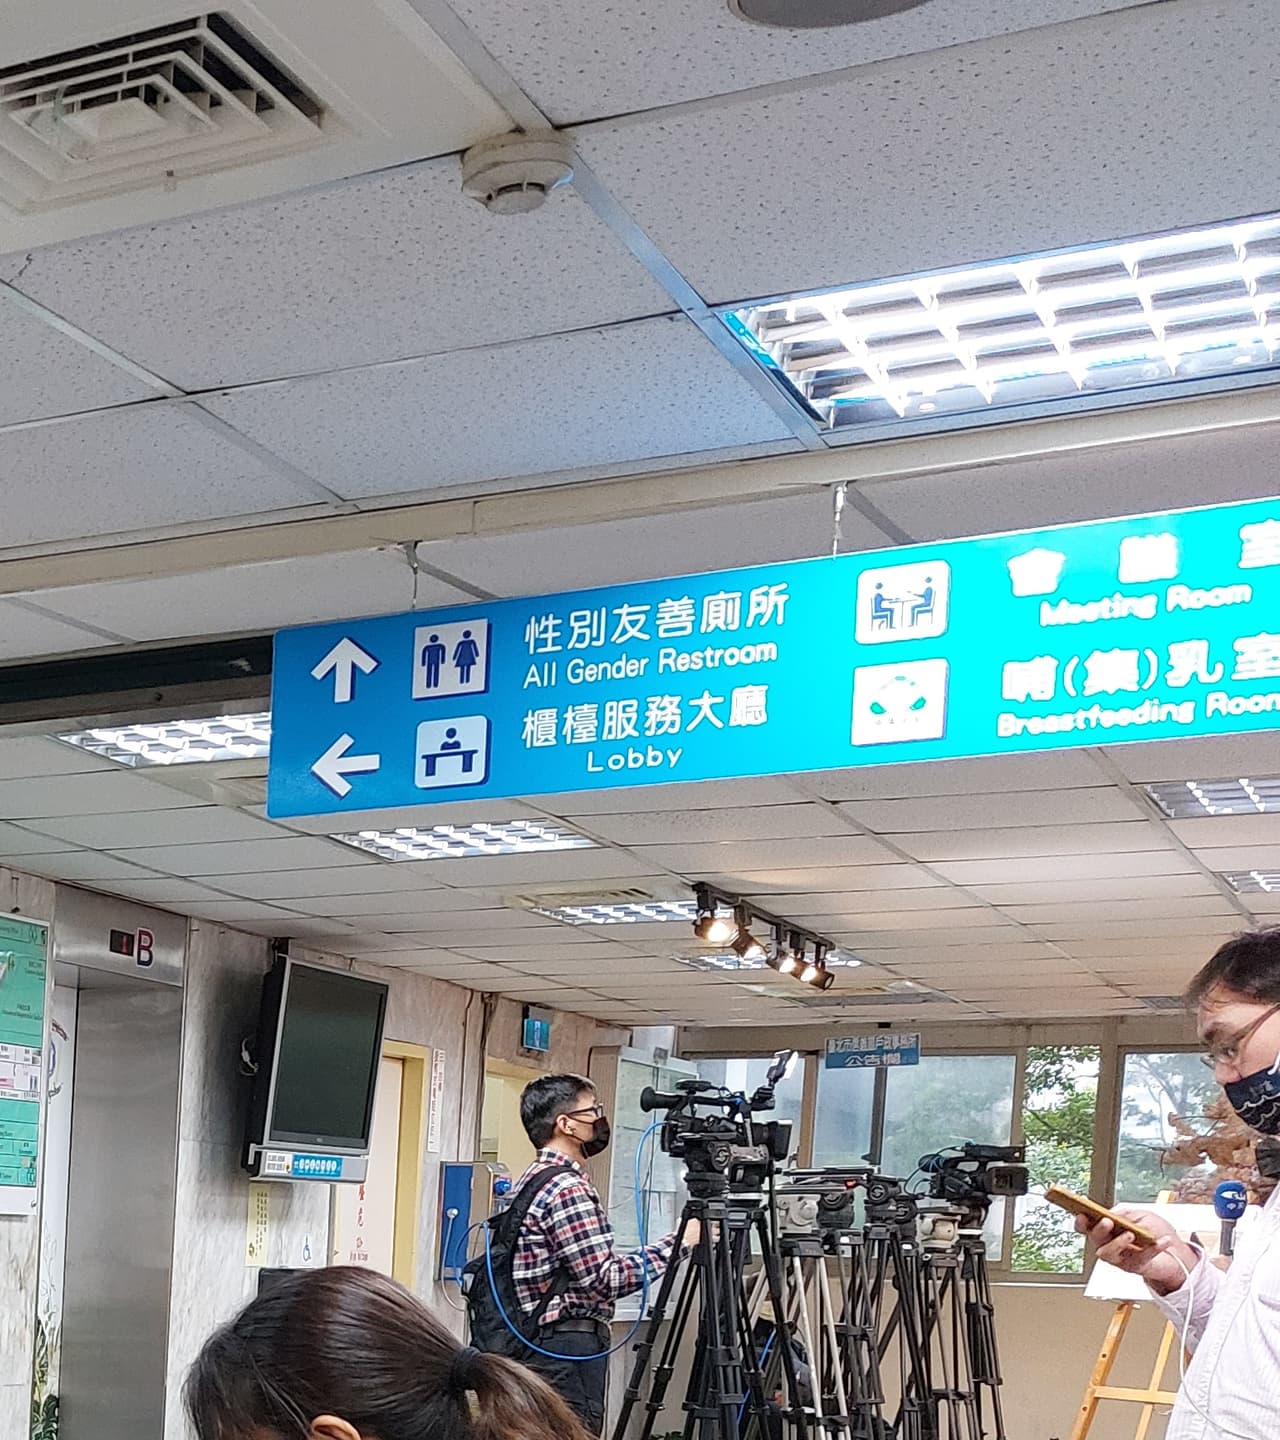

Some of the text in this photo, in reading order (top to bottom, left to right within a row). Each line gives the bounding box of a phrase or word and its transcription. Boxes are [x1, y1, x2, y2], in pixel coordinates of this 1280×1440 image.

[523, 582, 790, 657] 性別友善廁所
[1040, 584, 1252, 627] Meeting Room
[523, 640, 778, 690] All Gender Restroom
[521, 684, 770, 750] 櫃檯服務大廳
[996, 698, 1196, 738] Breastfeeding
[587, 745, 684, 774] Lobby
[136, 928, 155, 967] B
